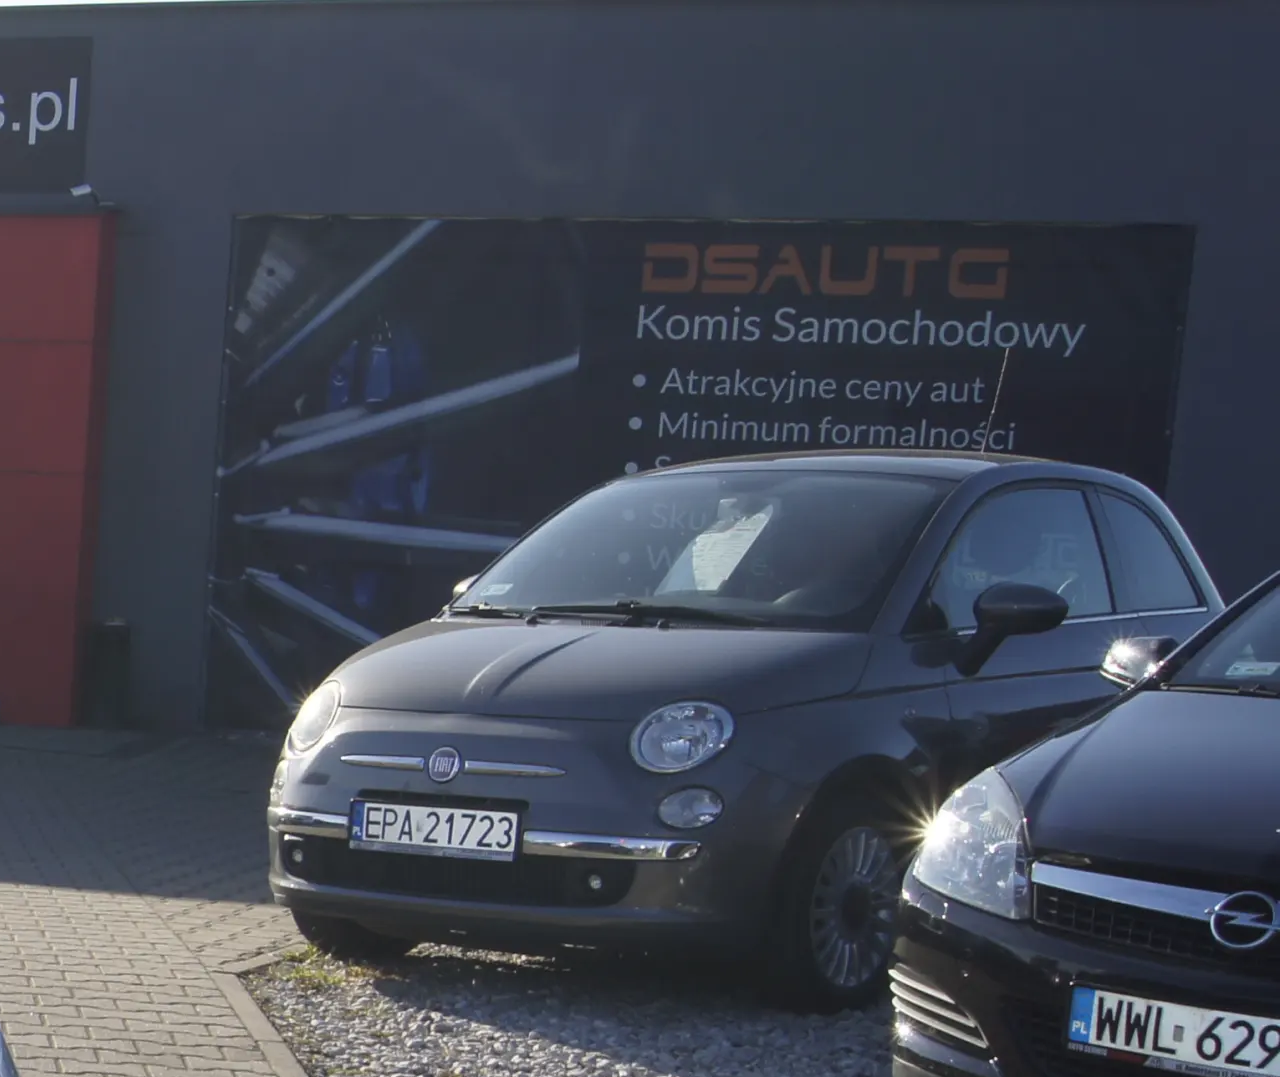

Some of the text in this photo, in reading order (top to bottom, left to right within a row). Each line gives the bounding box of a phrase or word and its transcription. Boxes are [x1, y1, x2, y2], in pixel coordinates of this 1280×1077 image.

[637, 305, 1085, 357] Komis Samochodowy
[660, 367, 984, 405] Atrakcyjne ceny aut
[658, 411, 1016, 451] Minimum formalności
[365, 806, 514, 850] EPA 21723
[1072, 1020, 1088, 1035] PL
[1095, 997, 1280, 1070] WWL 629
